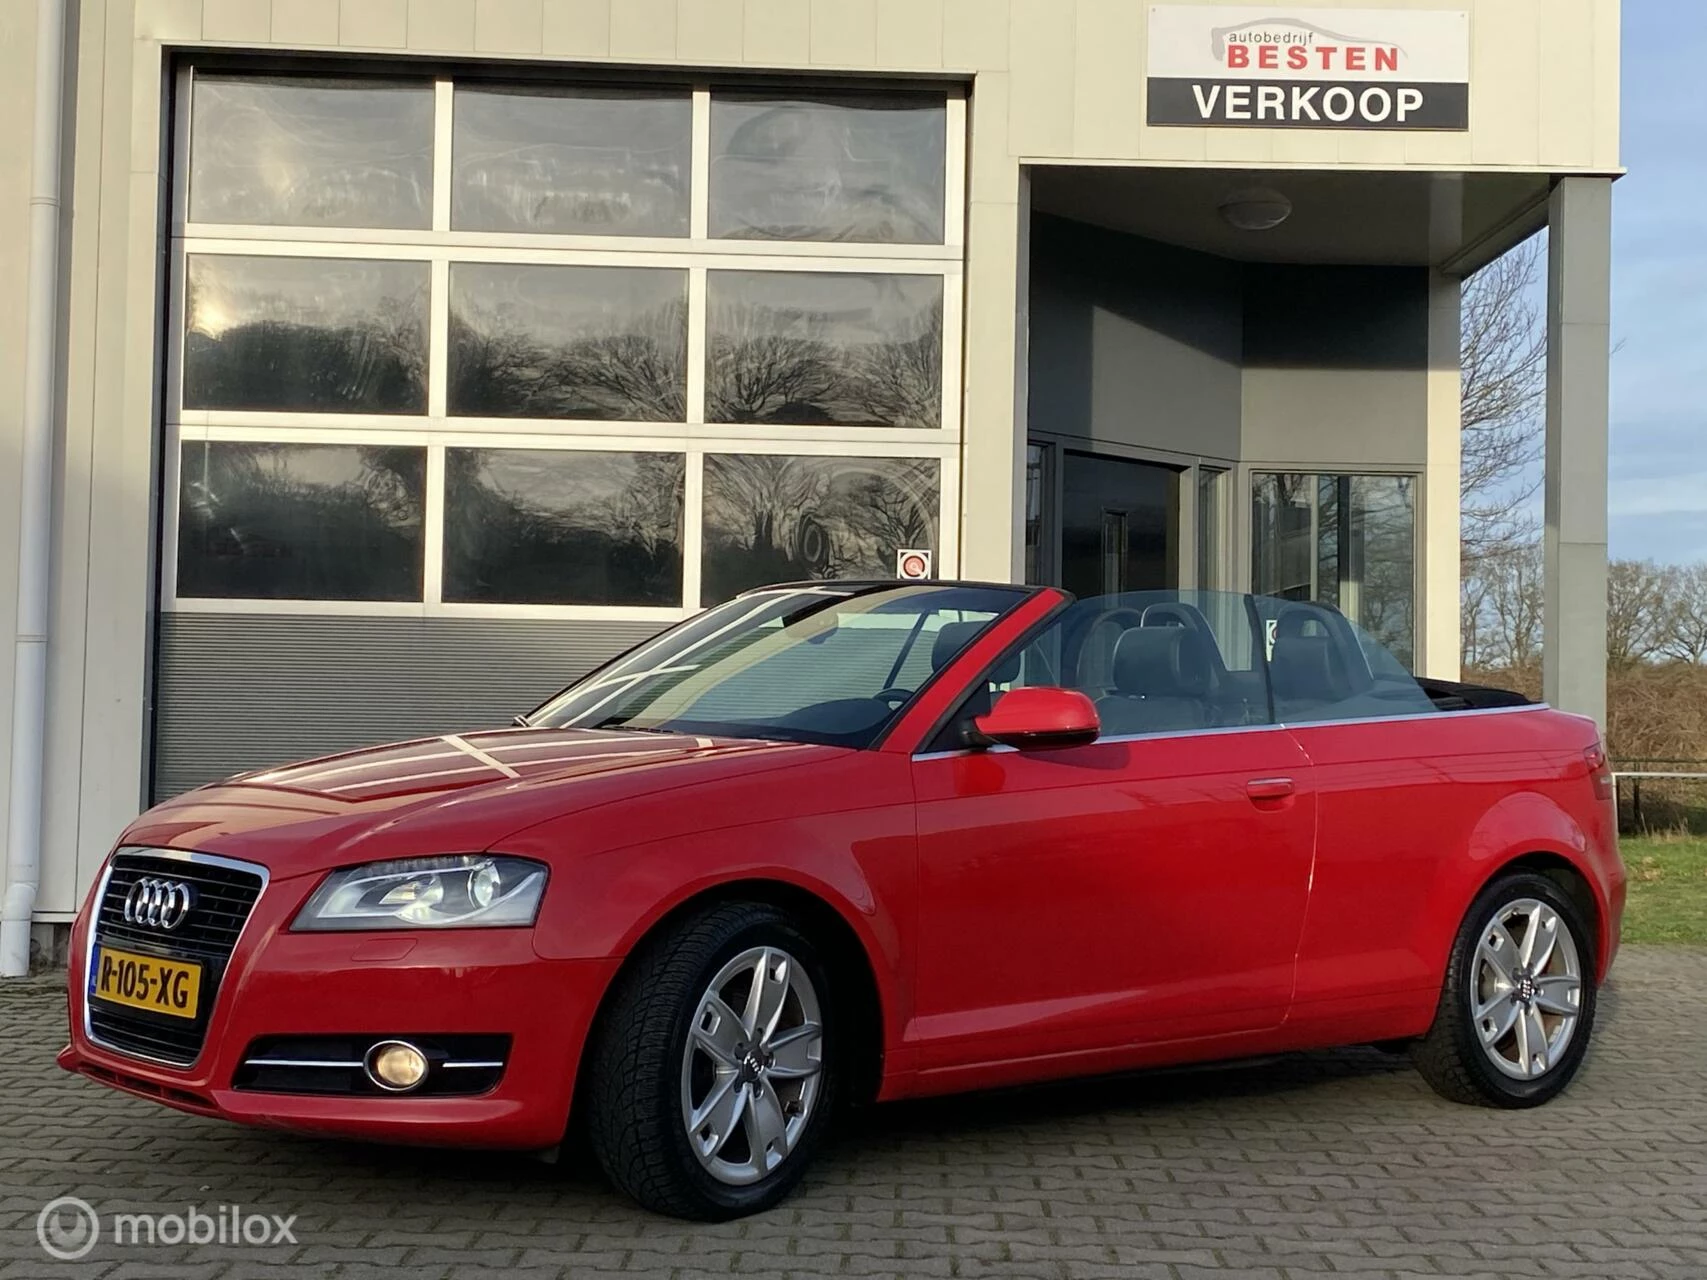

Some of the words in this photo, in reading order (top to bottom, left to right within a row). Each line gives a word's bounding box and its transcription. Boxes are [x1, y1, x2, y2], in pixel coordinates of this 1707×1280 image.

[1228, 31, 1314, 46] autobedrijf
[1228, 45, 1398, 71] BESTEN
[1192, 84, 1424, 122] VERKOOP
[100, 955, 190, 1009] R-105-XG
